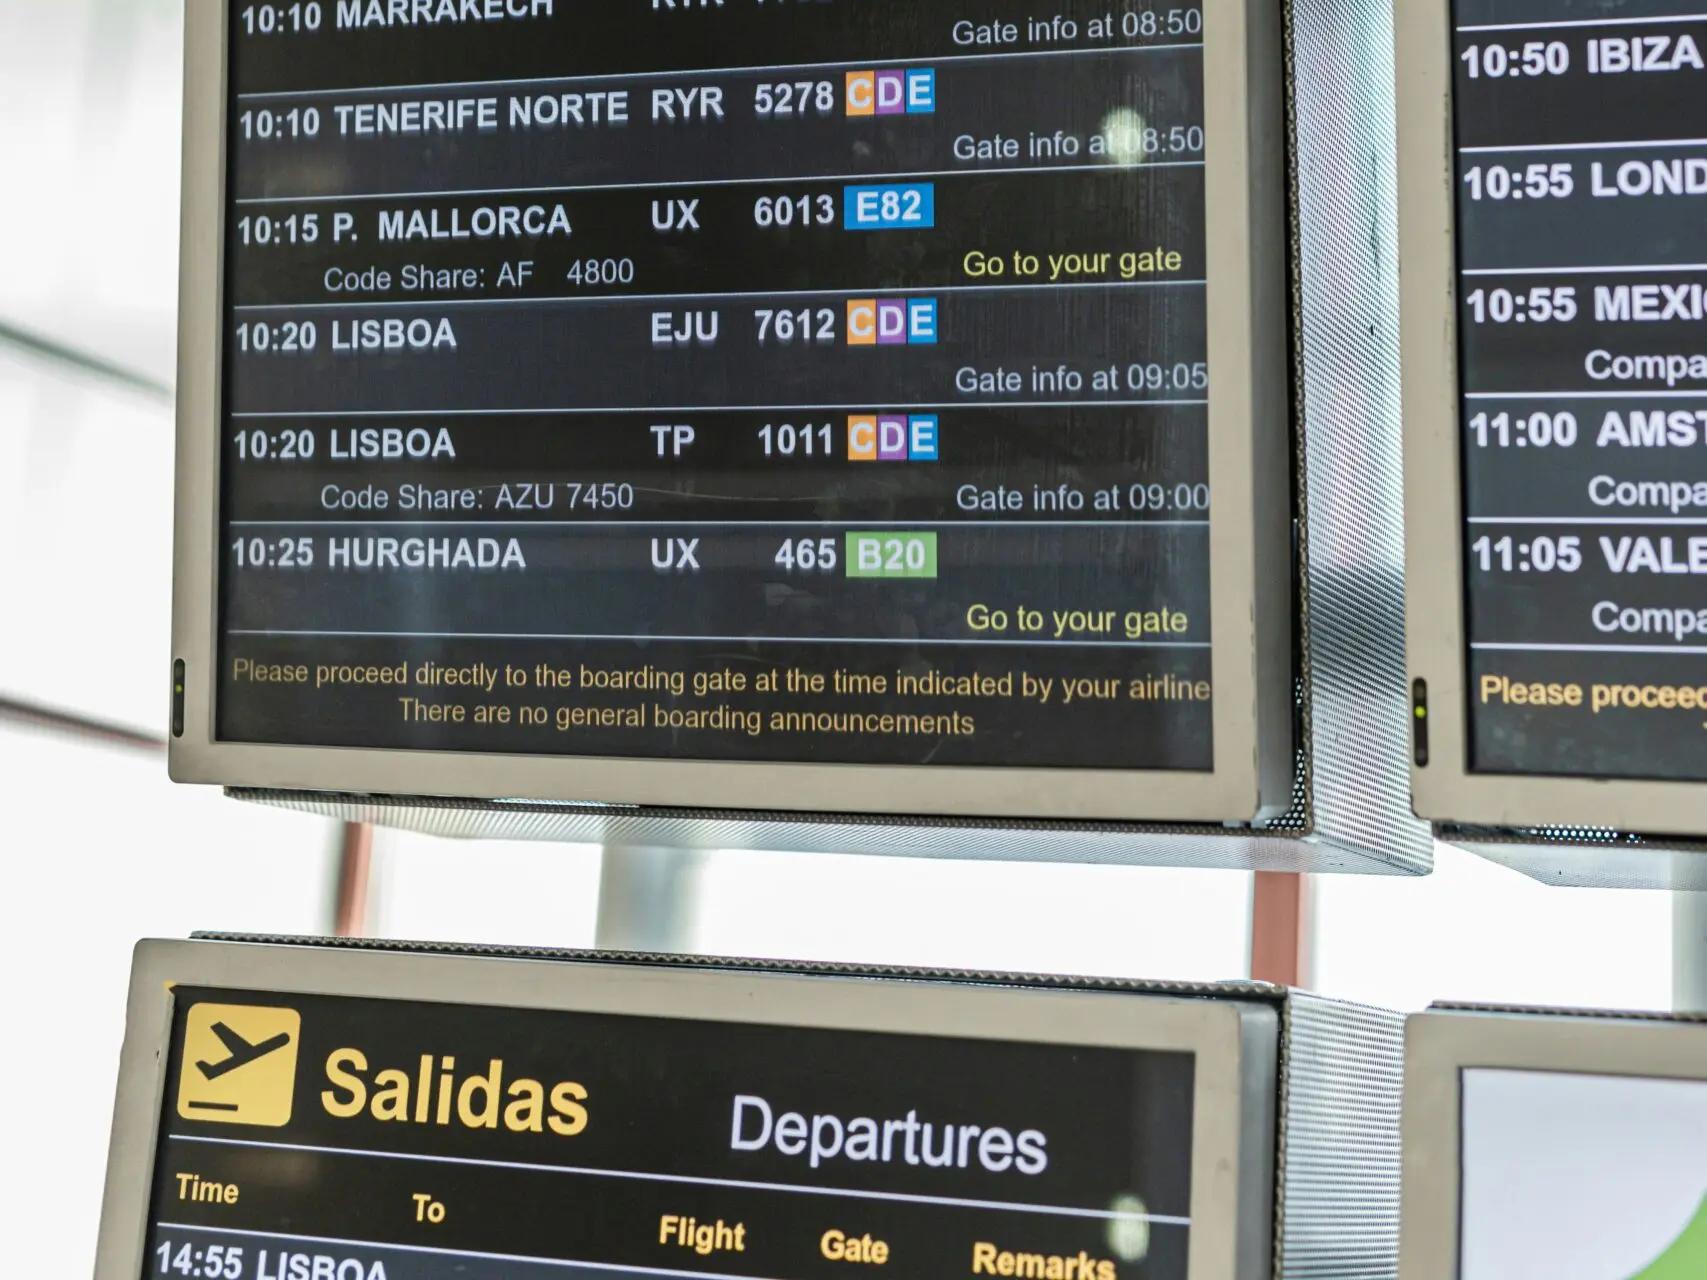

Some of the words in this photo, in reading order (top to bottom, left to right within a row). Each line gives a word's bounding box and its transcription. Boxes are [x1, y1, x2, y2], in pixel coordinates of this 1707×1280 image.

[242, 3, 321, 34] 10:10
[953, 21, 1017, 45] Gate
[1028, 16, 1077, 41] info
[1088, 13, 1113, 38] at
[1123, 10, 1201, 36] 08:50
[1461, 42, 1569, 78] 10:50
[1587, 35, 1703, 73] IBIZA
[240, 109, 320, 139] 10:10
[334, 98, 497, 135] TENERIFE
[510, 92, 628, 125] NORTE
[652, 87, 724, 118] RYR
[755, 82, 833, 113] 5278
[1464, 164, 1573, 200] 10:55
[238, 214, 318, 244] 10:15
[333, 214, 358, 242] P.
[378, 205, 572, 241] MALLORCA
[652, 199, 700, 229] UX
[754, 195, 834, 226] 6013
[857, 191, 921, 222] E82
[324, 267, 391, 291] Code
[401, 264, 485, 289] Share:
[497, 261, 534, 287] AF
[567, 259, 634, 285] 4800
[1467, 287, 1577, 322] 10:55
[236, 321, 316, 351] 10:20
[332, 319, 457, 350] LISBOA
[652, 311, 718, 342] EJU
[755, 309, 835, 340] 7612
[234, 429, 315, 458] 10:20
[331, 428, 455, 458] LISBOA
[650, 426, 695, 455] TP
[758, 424, 831, 454] 1011
[1469, 412, 1577, 447] 11:00
[321, 485, 388, 510] Code
[399, 484, 482, 509] Share:
[495, 484, 553, 509] AZU
[566, 483, 633, 509] 7450
[956, 485, 1022, 510] Gate
[1034, 484, 1083, 510] info
[1094, 486, 1119, 510] at
[1130, 484, 1209, 510] 09:00
[232, 538, 314, 568] 10:25
[329, 538, 526, 568] HURGHADA
[651, 538, 699, 568] UX
[775, 538, 836, 569] 465
[858, 538, 925, 569] B20
[1472, 537, 1582, 571] 11:05
[967, 605, 1007, 630] Go
[1018, 606, 1042, 630] to
[1053, 610, 1116, 638] your
[1125, 608, 1187, 638] gate
[233, 659, 308, 682] Please
[317, 661, 407, 688] proceed
[416, 662, 497, 692] directly
[505, 665, 526, 687] to
[536, 665, 571, 687] the
[580, 666, 685, 695] boarding
[693, 673, 746, 696] gate
[755, 672, 778, 692] at
[787, 669, 825, 693] the
[834, 670, 888, 694] time
[896, 671, 1013, 697] indicated
[1024, 674, 1052, 703] by
[1062, 678, 1119, 704] your
[1129, 674, 1211, 699] airline
[1481, 675, 1582, 705] Please
[400, 698, 465, 722] There
[474, 703, 510, 723] are
[519, 705, 548, 724] no
[557, 704, 645, 730] general
[655, 704, 761, 735] boarding
[770, 710, 975, 735] announcements
[321, 1048, 589, 1136] Salidas
[730, 1095, 1048, 1175] Departures
[176, 1173, 239, 1204] Time
[413, 1194, 446, 1223] To
[660, 1215, 745, 1256] Flight
[820, 1230, 889, 1264] Gate
[973, 1243, 1116, 1280] Remarks
[157, 1241, 243, 1280] 14:55
